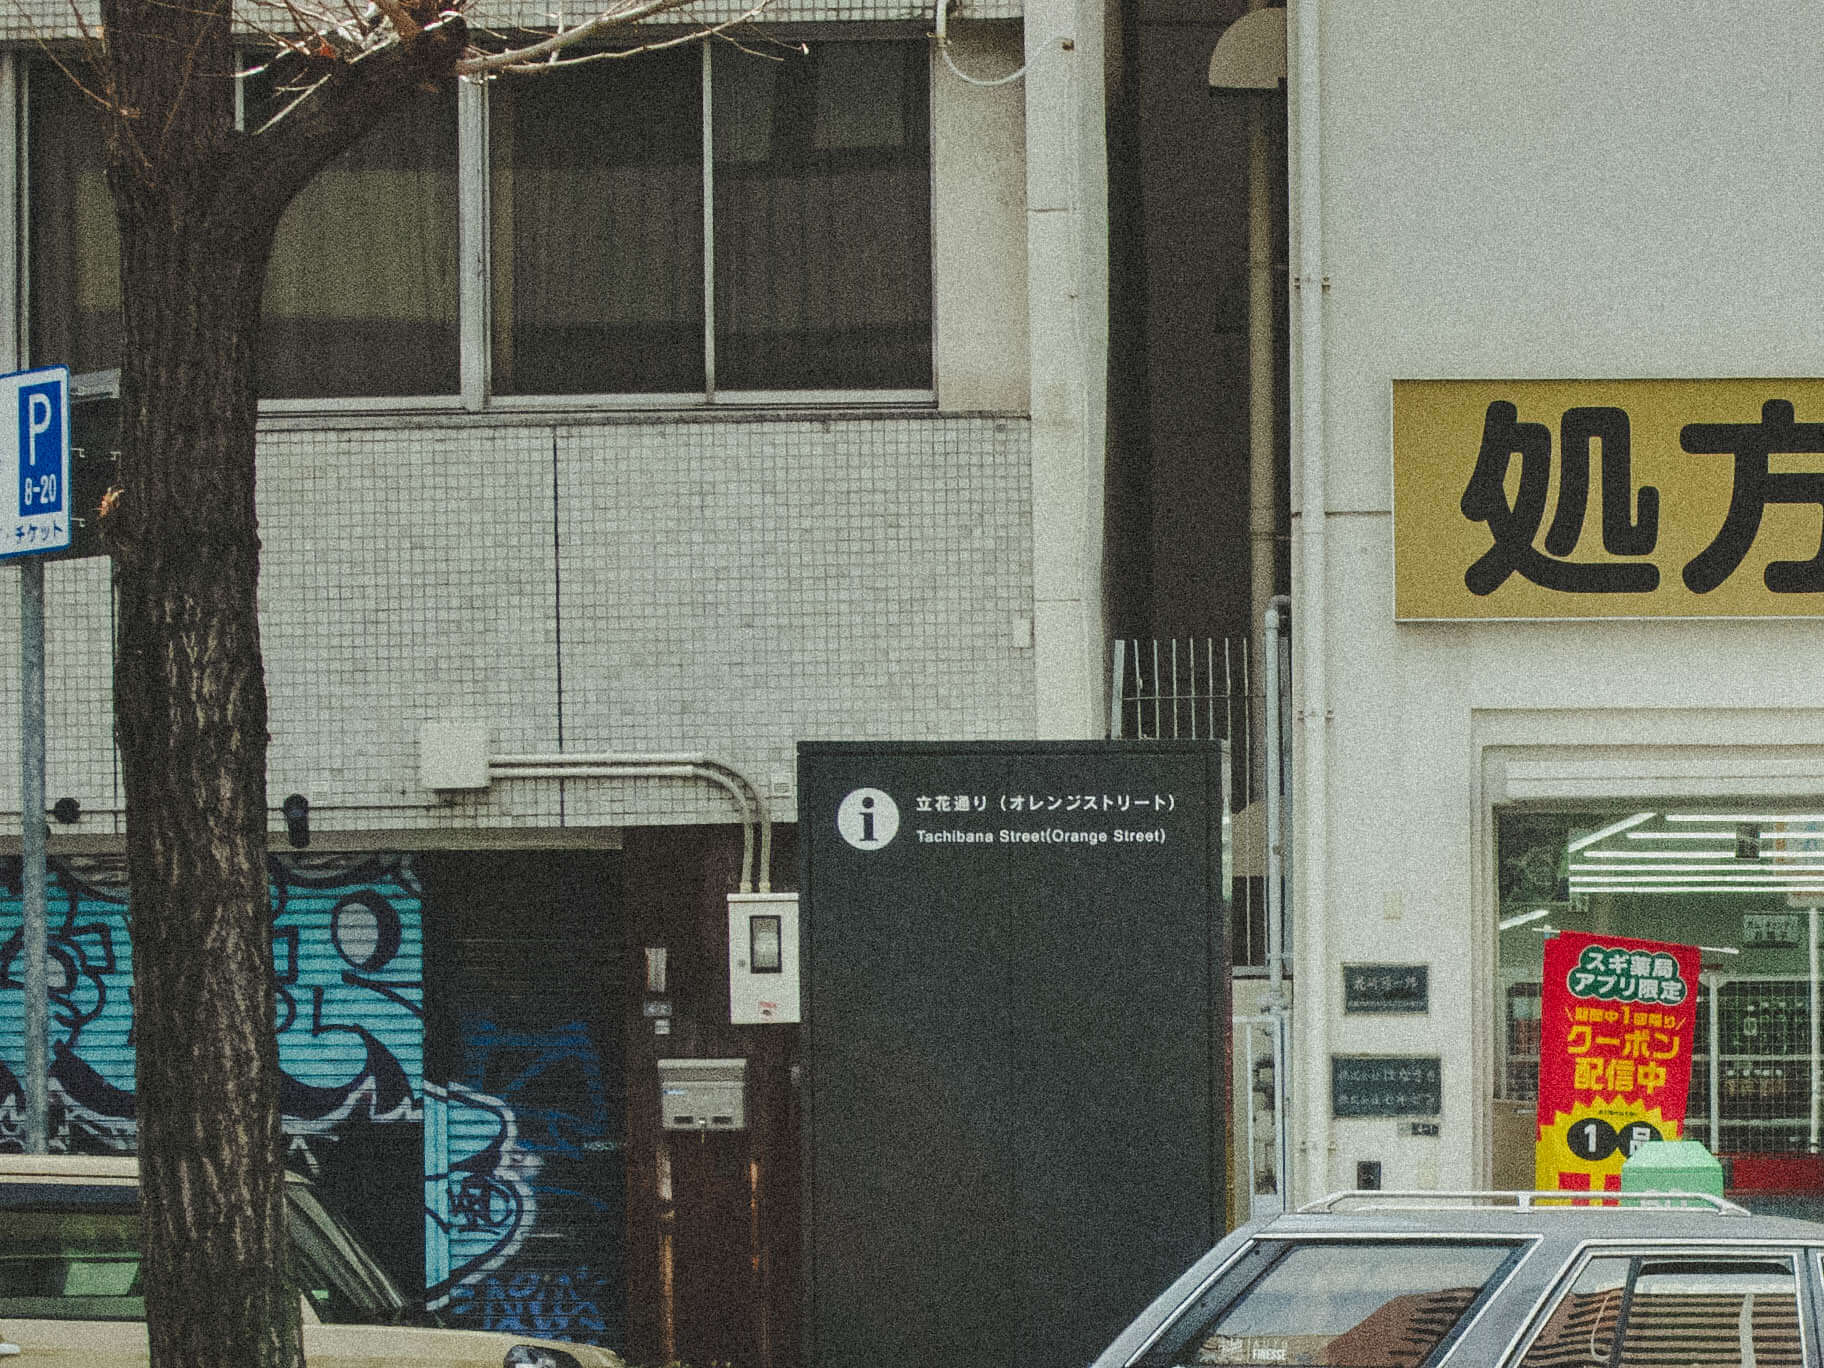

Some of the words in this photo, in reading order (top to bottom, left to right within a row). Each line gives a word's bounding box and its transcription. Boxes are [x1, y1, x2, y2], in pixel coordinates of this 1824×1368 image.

[28, 392, 52, 467] P
[24, 473, 57, 506] 8-20
[917, 829, 994, 843] Tachibana
[1113, 828, 1166, 845] Street)
[1586, 952, 1674, 978] スギ薬局
[1575, 972, 1682, 1001] アプリ限定
[1567, 1025, 1680, 1059] クーポン
[1574, 1056, 1667, 1094] 配信中
